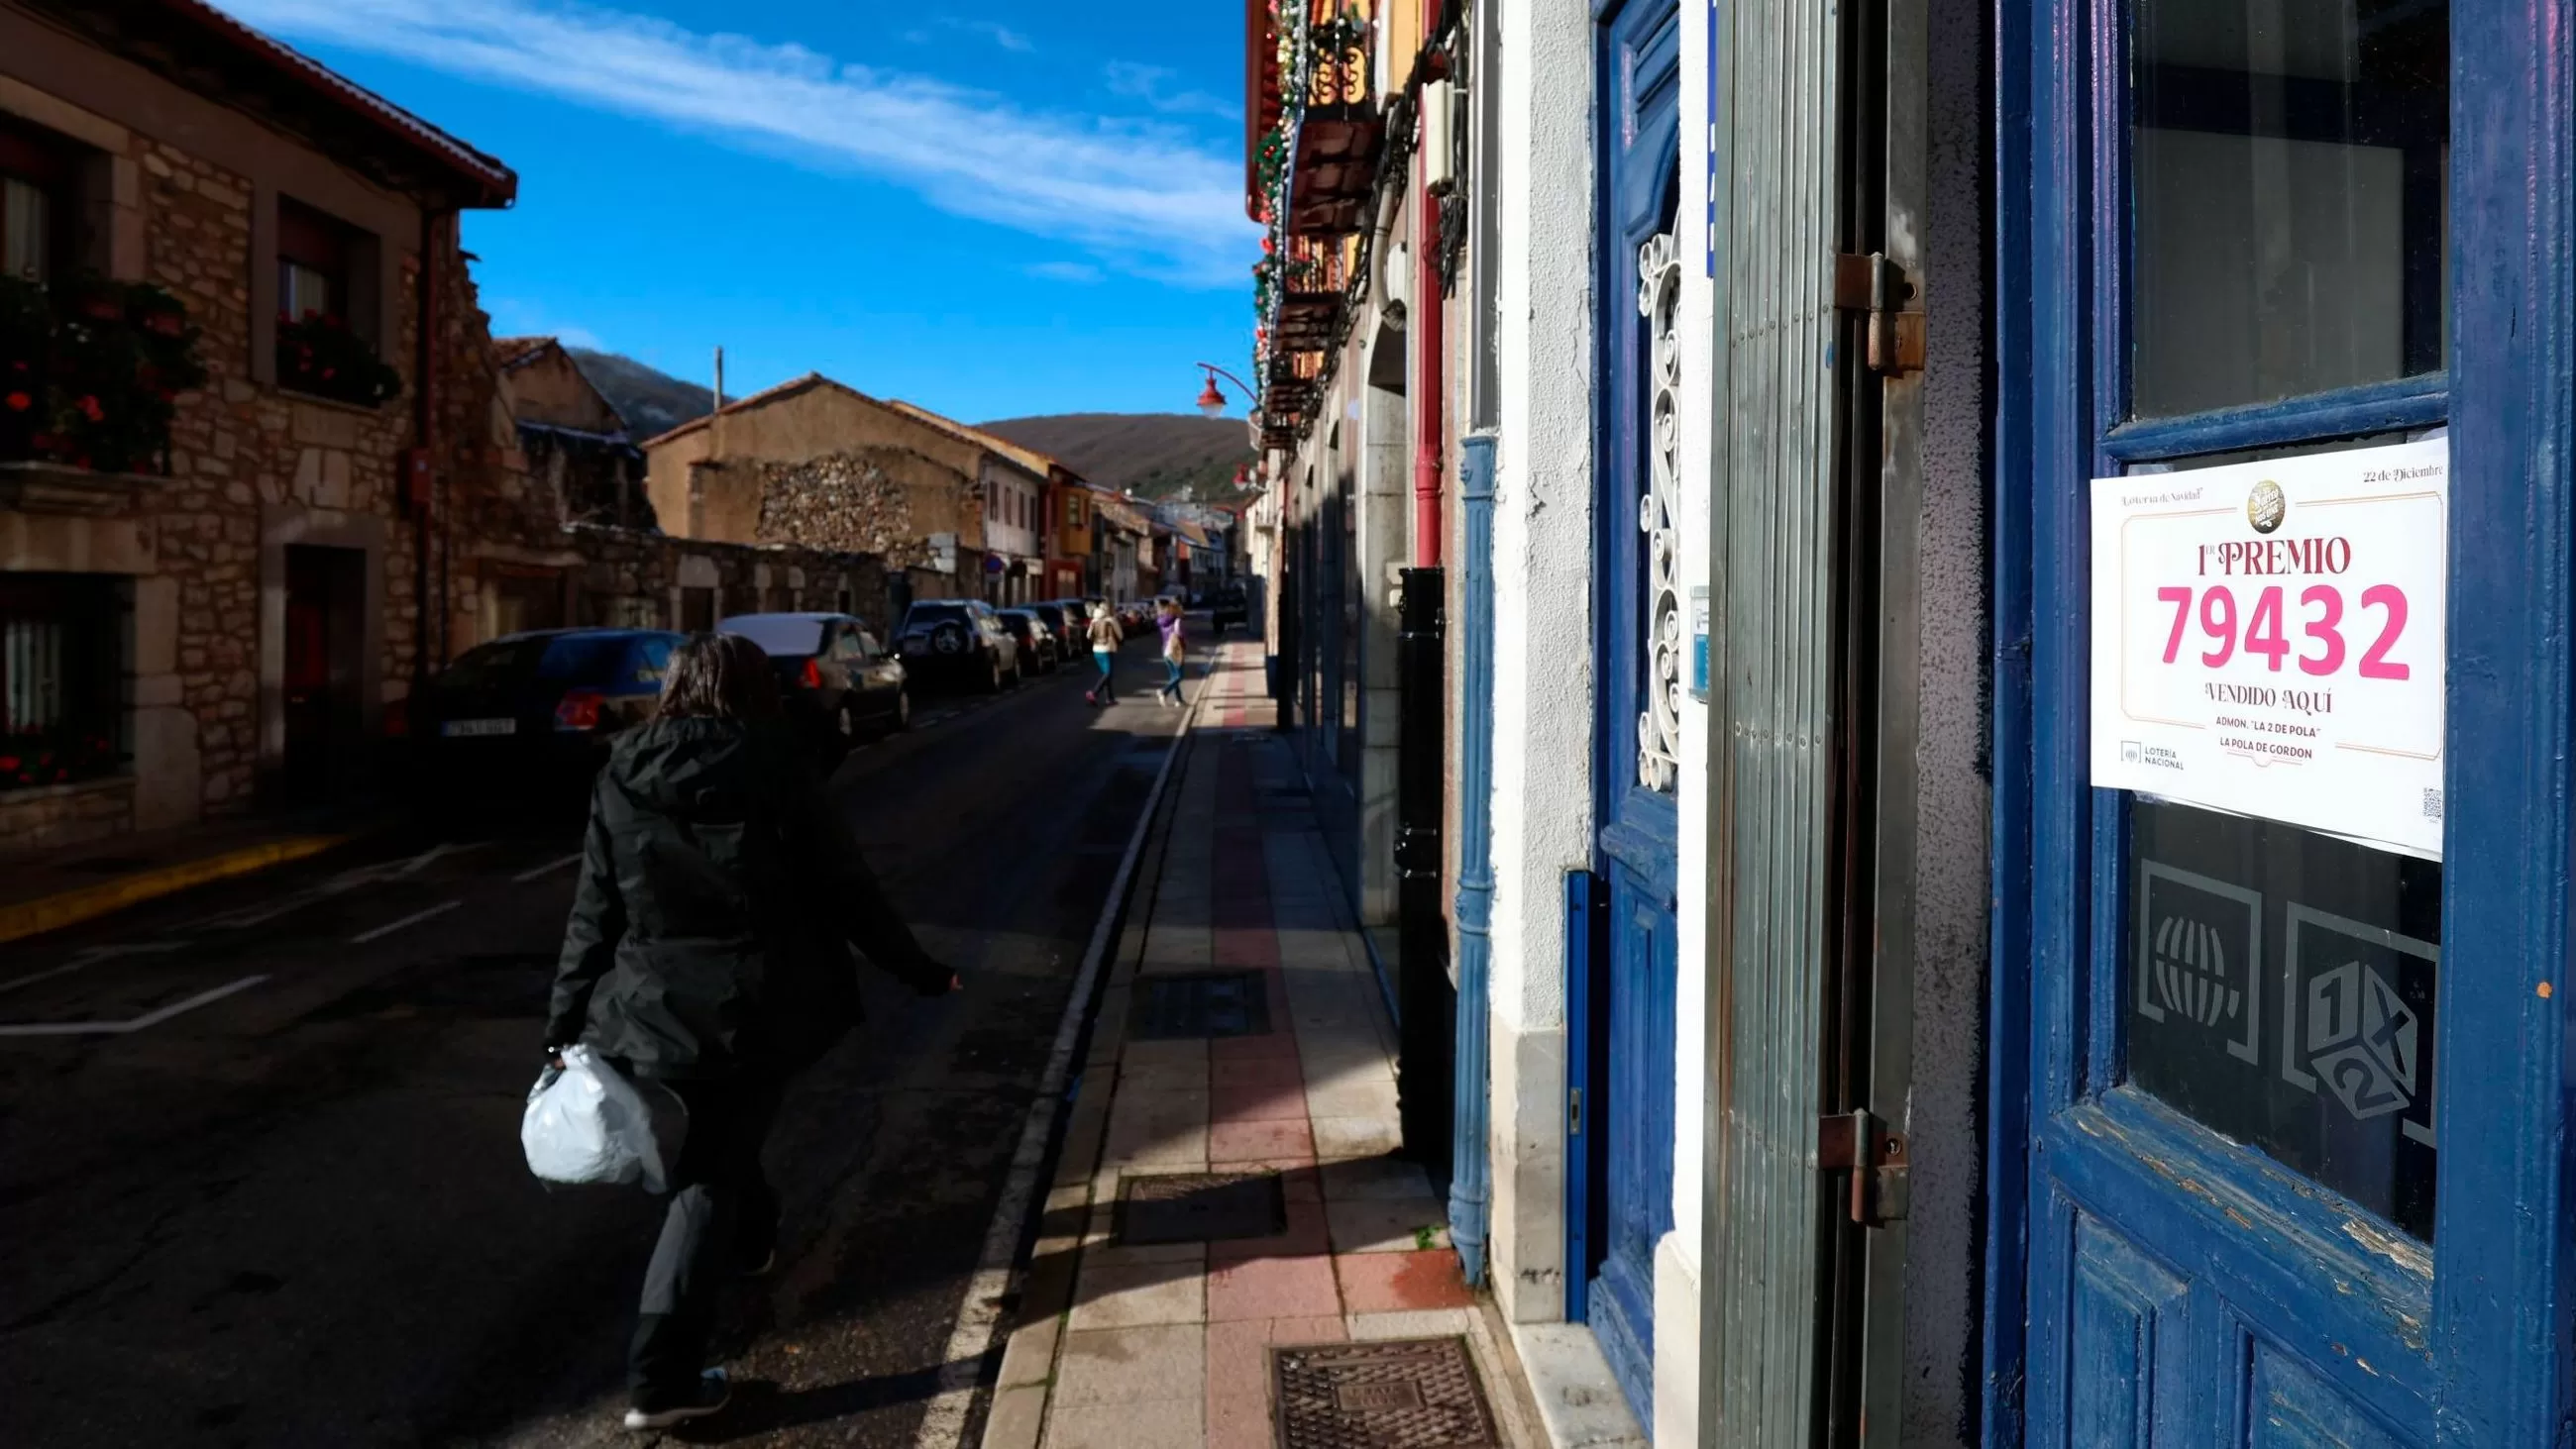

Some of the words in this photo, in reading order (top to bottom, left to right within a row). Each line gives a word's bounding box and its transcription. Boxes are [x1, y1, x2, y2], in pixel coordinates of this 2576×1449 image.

[2363, 471, 2376, 482] 22
[2378, 469, 2391, 481] de
[2393, 465, 2443, 481] Diciembre
[2160, 492, 2170, 503] de
[2217, 537, 2351, 575] PREMIO
[2157, 583, 2411, 680] 79432
[2204, 681, 2276, 707] VENDIDO
[2282, 687, 2331, 716] AQUÍ
[2216, 716, 2249, 729] ADMON.
[2267, 722, 2273, 732] 2
[2275, 723, 2288, 734] DE
[2219, 737, 2230, 747] LA
[2231, 738, 2254, 750] POLA
[2256, 742, 2268, 753] DE
[2269, 744, 2312, 759] GORDON
[2145, 756, 2184, 771] NACIONAL
